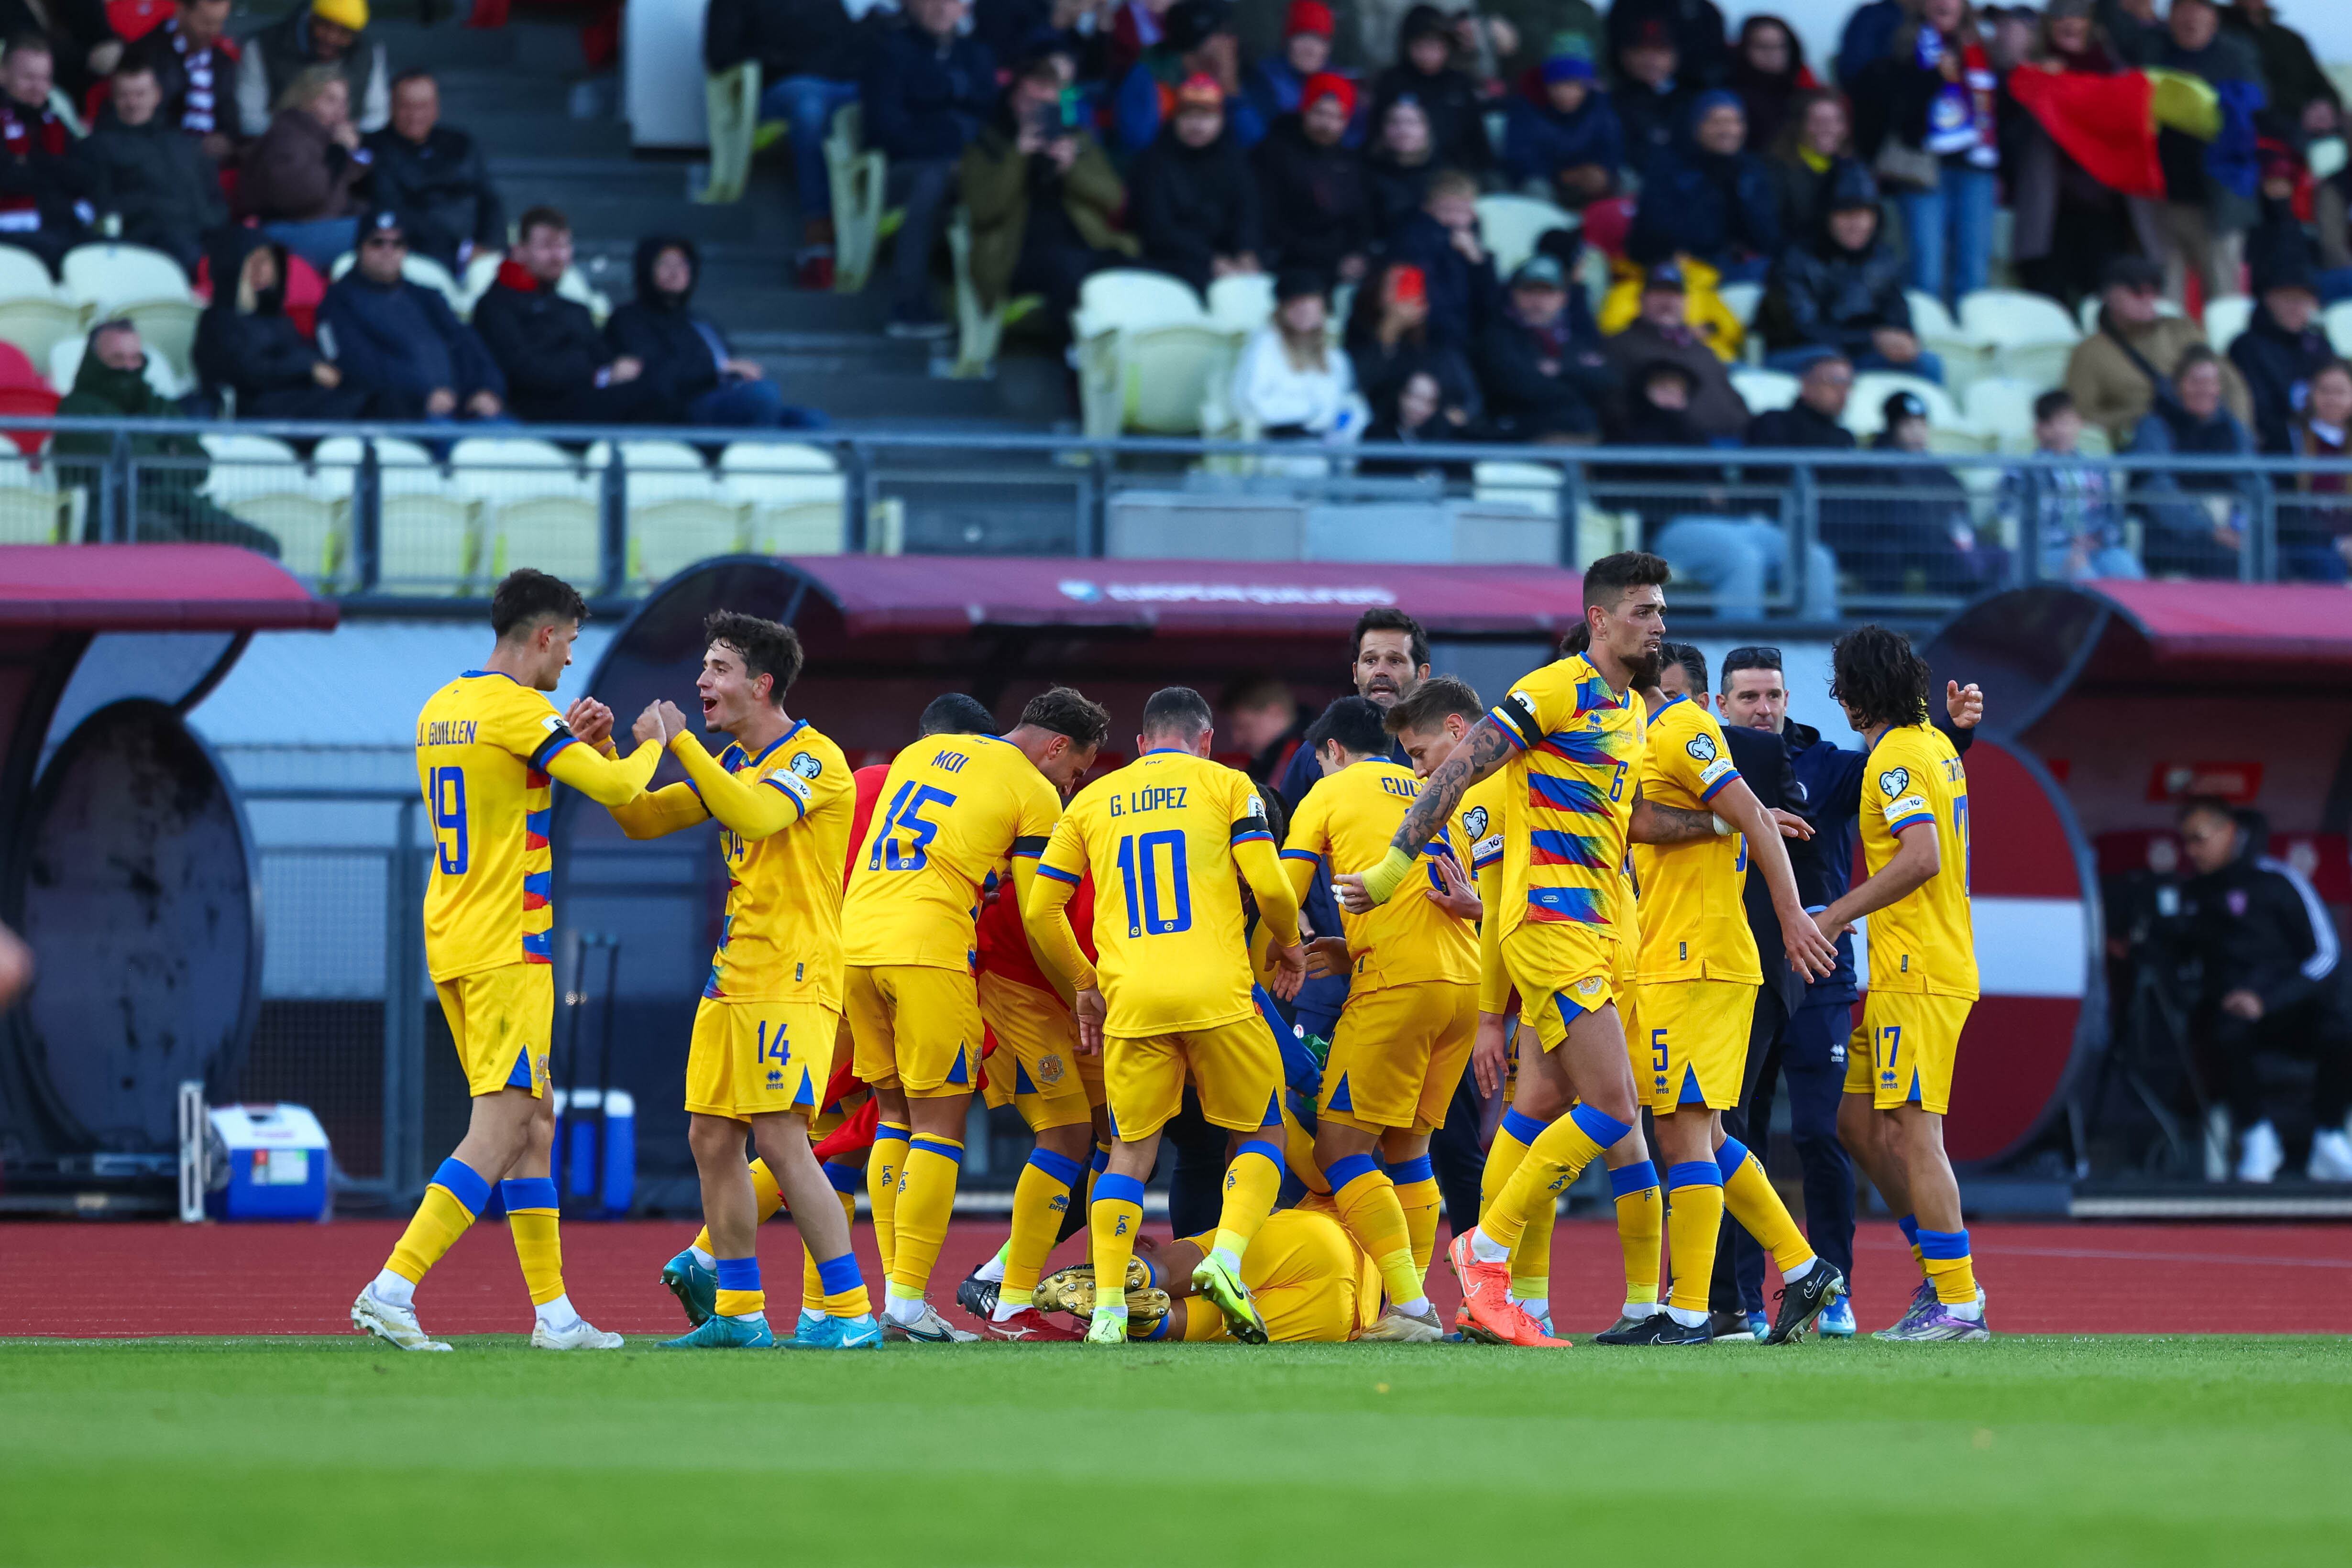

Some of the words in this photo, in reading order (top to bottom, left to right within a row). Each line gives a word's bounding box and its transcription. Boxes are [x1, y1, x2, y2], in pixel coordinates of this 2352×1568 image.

[417, 723, 425, 746] J.
[429, 721, 477, 746] GUILLEN
[931, 750, 970, 773] MOI
[1381, 777, 1424, 798] CUC
[1609, 760, 1628, 802] 6
[1110, 794, 1126, 817] G.
[1132, 784, 1187, 813] LÓPEZ
[429, 767, 468, 874] 19
[868, 780, 957, 871] 15
[1117, 829, 1192, 939] 10
[758, 1020, 791, 1066] 14
[1652, 1029, 1668, 1072] 5
[1875, 1026, 1901, 1068] 17
[882, 1165, 893, 1186] FAF
[898, 1172, 909, 1195] FAF
[1227, 1168, 1238, 1191] FAF
[1548, 1174, 1572, 1190] FAF
[1115, 1215, 1130, 1237] FAF
